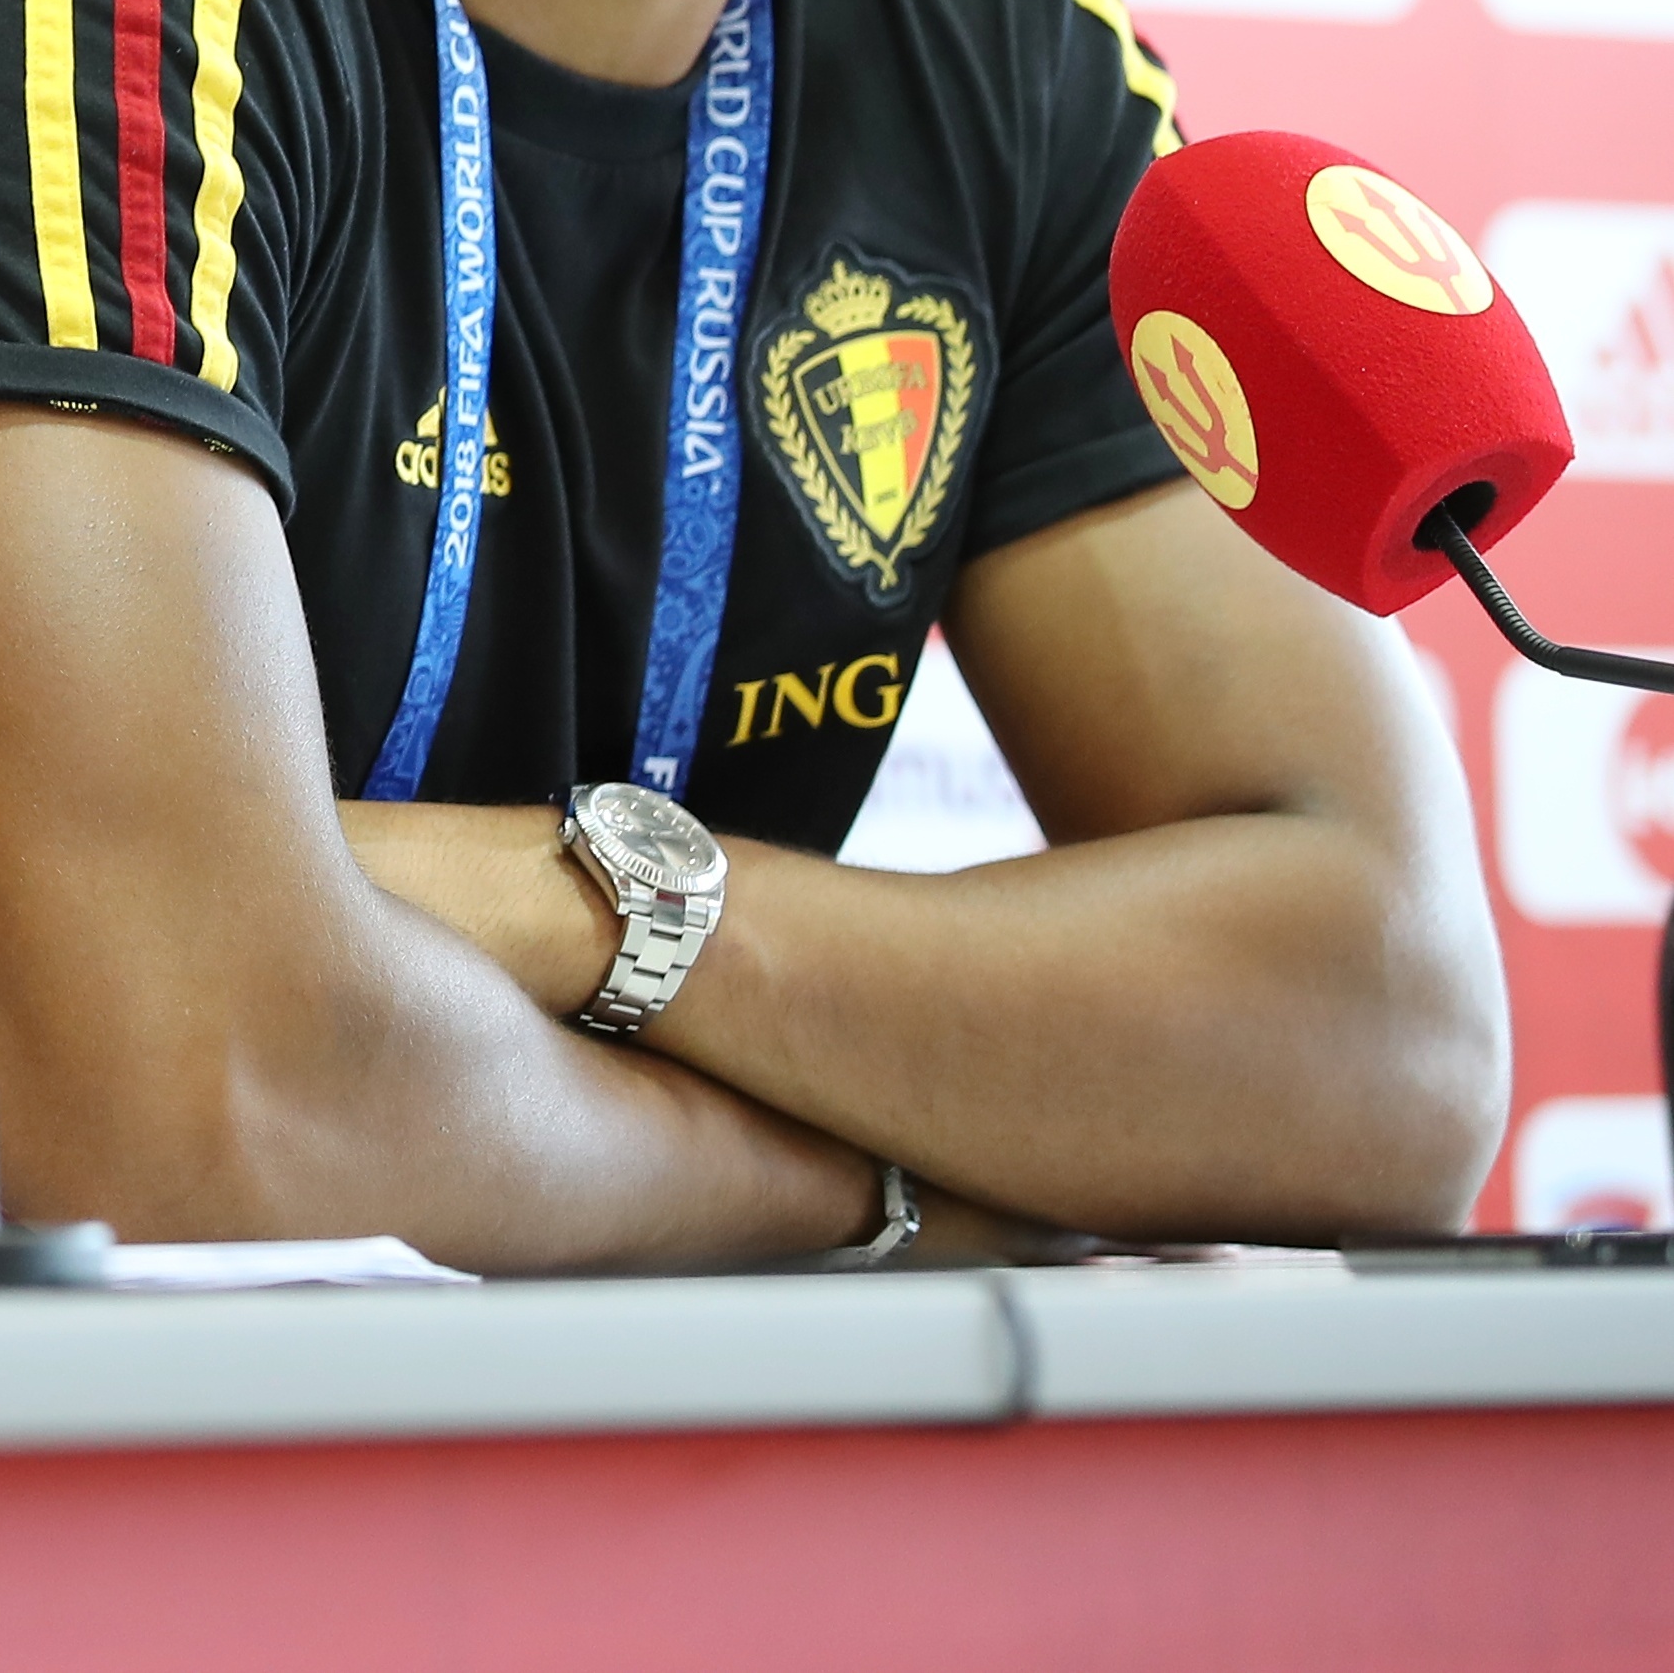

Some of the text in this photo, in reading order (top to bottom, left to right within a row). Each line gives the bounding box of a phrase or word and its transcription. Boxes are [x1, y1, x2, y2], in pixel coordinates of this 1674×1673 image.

[452, 83, 485, 300] WORLD
[701, 135, 749, 258] CUP
[457, 306, 485, 427] FIFA
[683, 266, 739, 479] RUSSIA
[443, 438, 481, 569] 2018
[726, 653, 904, 747] ING
